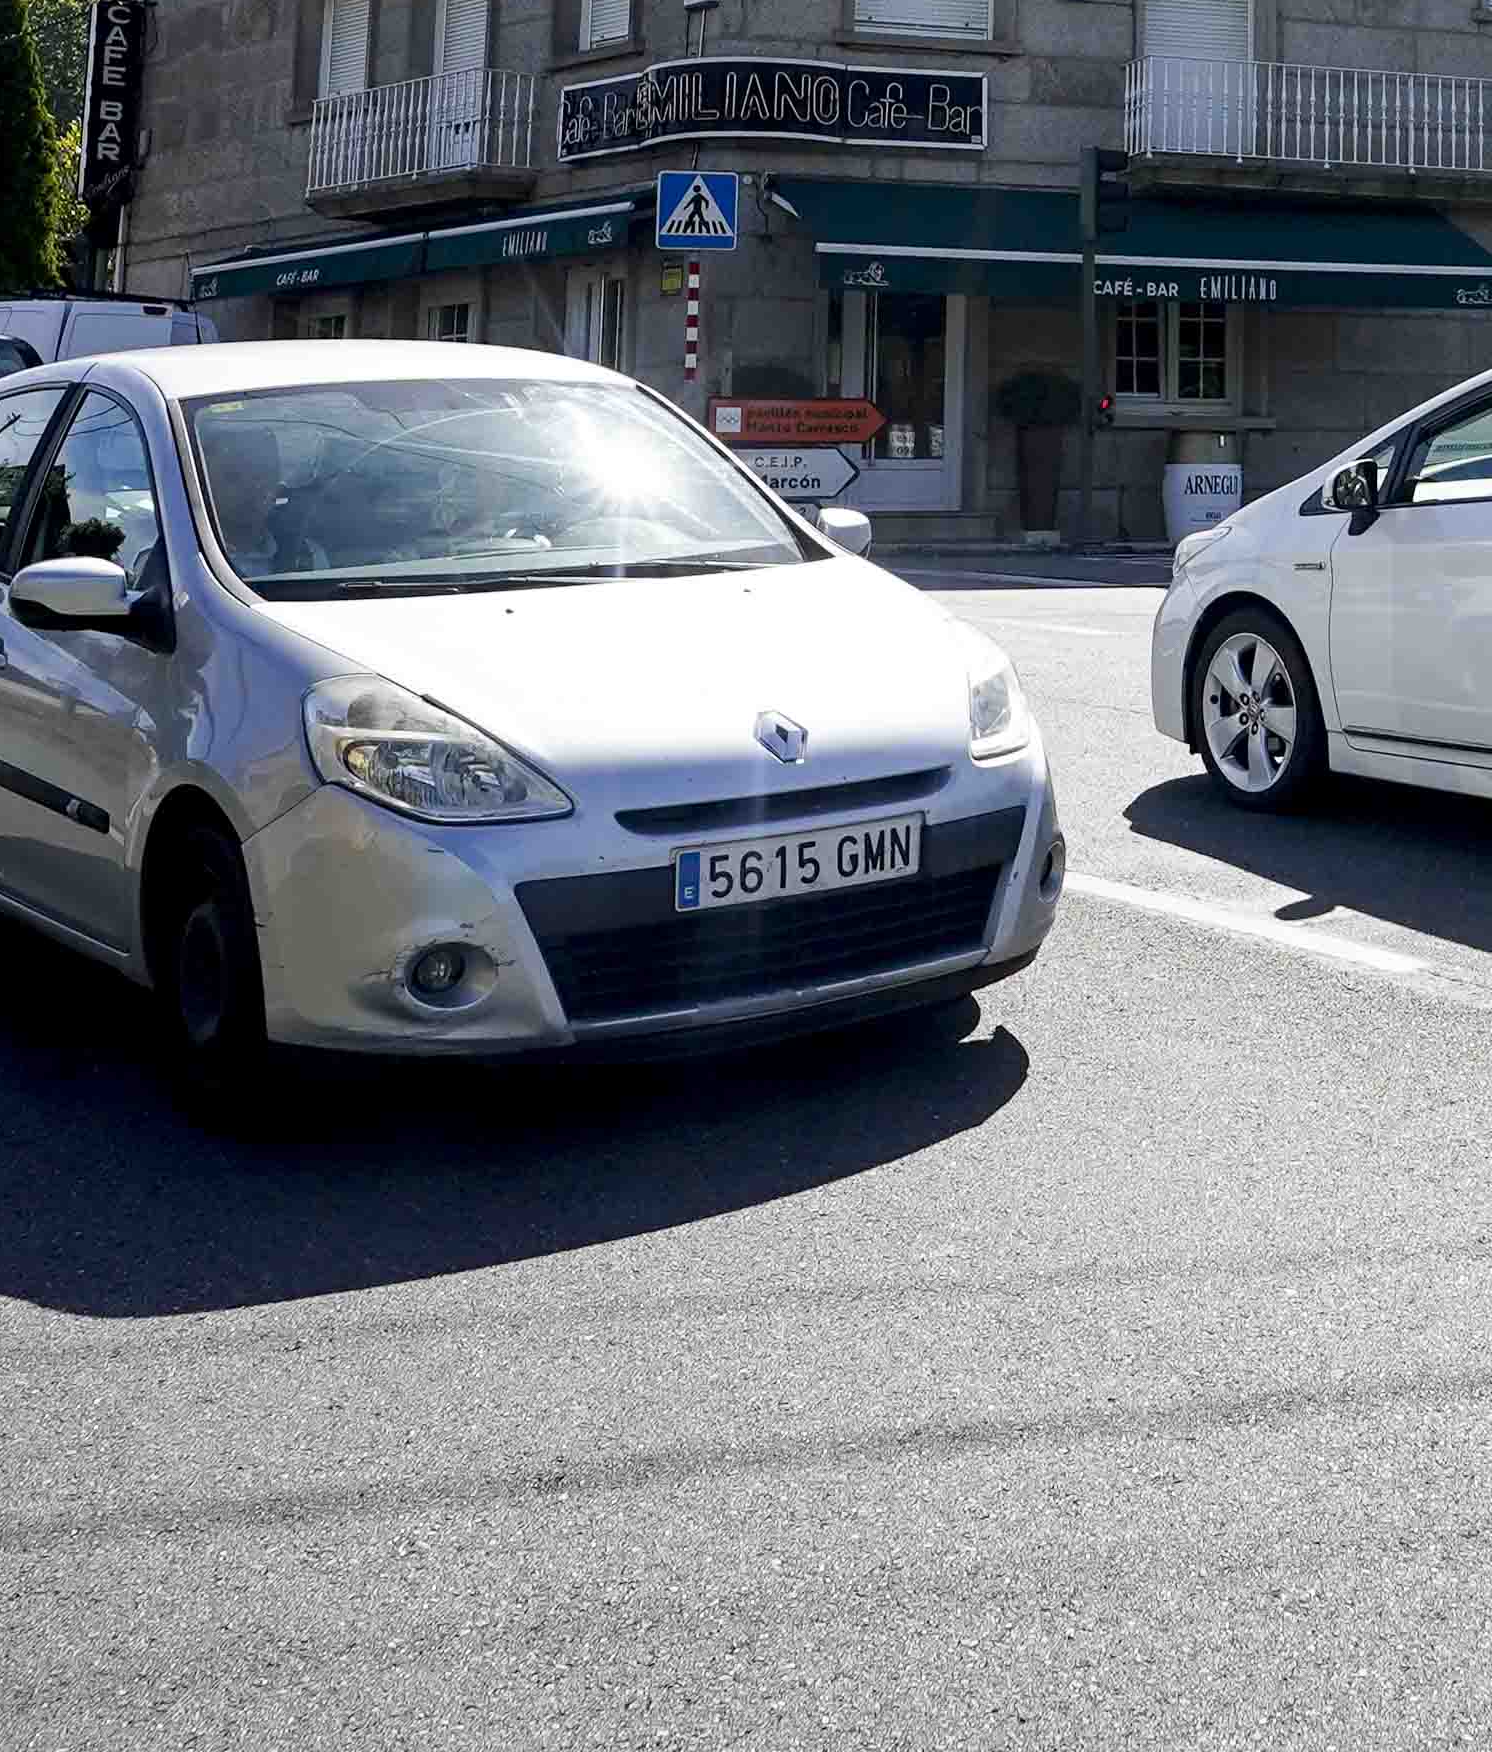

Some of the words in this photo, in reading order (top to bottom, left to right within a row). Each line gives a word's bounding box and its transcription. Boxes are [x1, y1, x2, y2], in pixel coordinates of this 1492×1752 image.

[96, 99, 124, 160] BAR
[636, 72, 840, 130] EMILIANO
[1200, 275, 1277, 300] EMILIANO
[755, 456, 807, 468] C.E.I.P.
[709, 841, 820, 898] 5615
[837, 825, 910, 878] GMN
